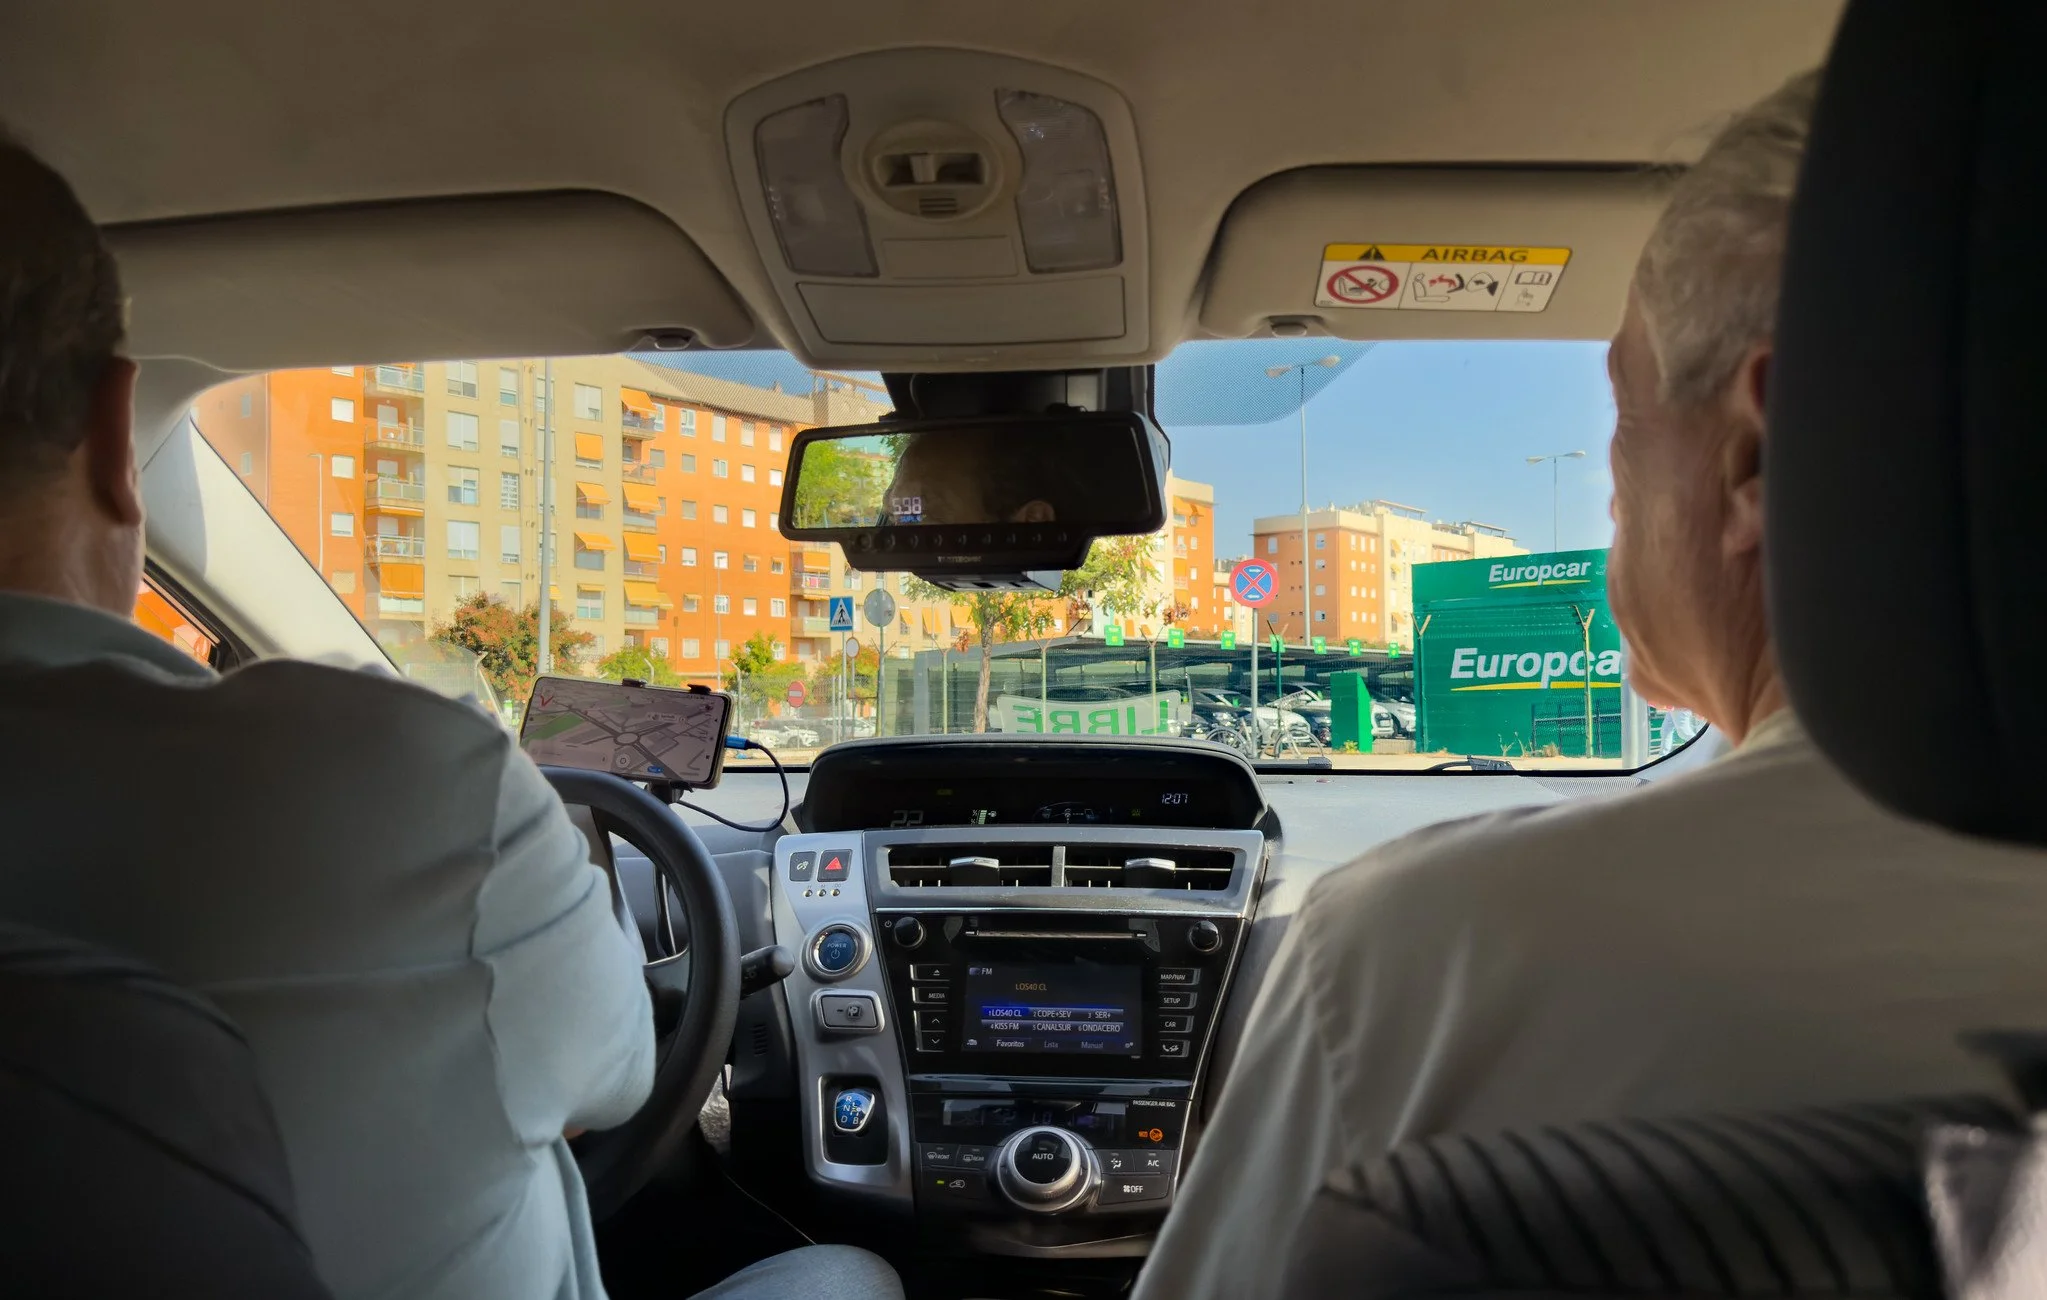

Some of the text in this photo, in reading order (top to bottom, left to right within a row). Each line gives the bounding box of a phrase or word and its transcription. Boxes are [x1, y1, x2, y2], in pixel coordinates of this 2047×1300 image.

[1421, 248, 1529, 263] AIRBAG
[1488, 562, 1592, 585] Europcar
[1450, 647, 1621, 689] Europca
[1162, 793, 1188, 804] 12:07
[1015, 983, 1047, 991] LOS40 CL
[1037, 1010, 1072, 1018] COPE+SEV
[1095, 1011, 1111, 1019] SER+
[994, 1022, 1008, 1030] KISS
[1036, 1022, 1072, 1031] CANALSUR
[1082, 1023, 1120, 1032] ONDACERO
[996, 1039, 1024, 1048] Favoritos
[1081, 1041, 1103, 1049] Manual
[1147, 1159, 1160, 1167] A/C
[1130, 1185, 1143, 1193] OFF
